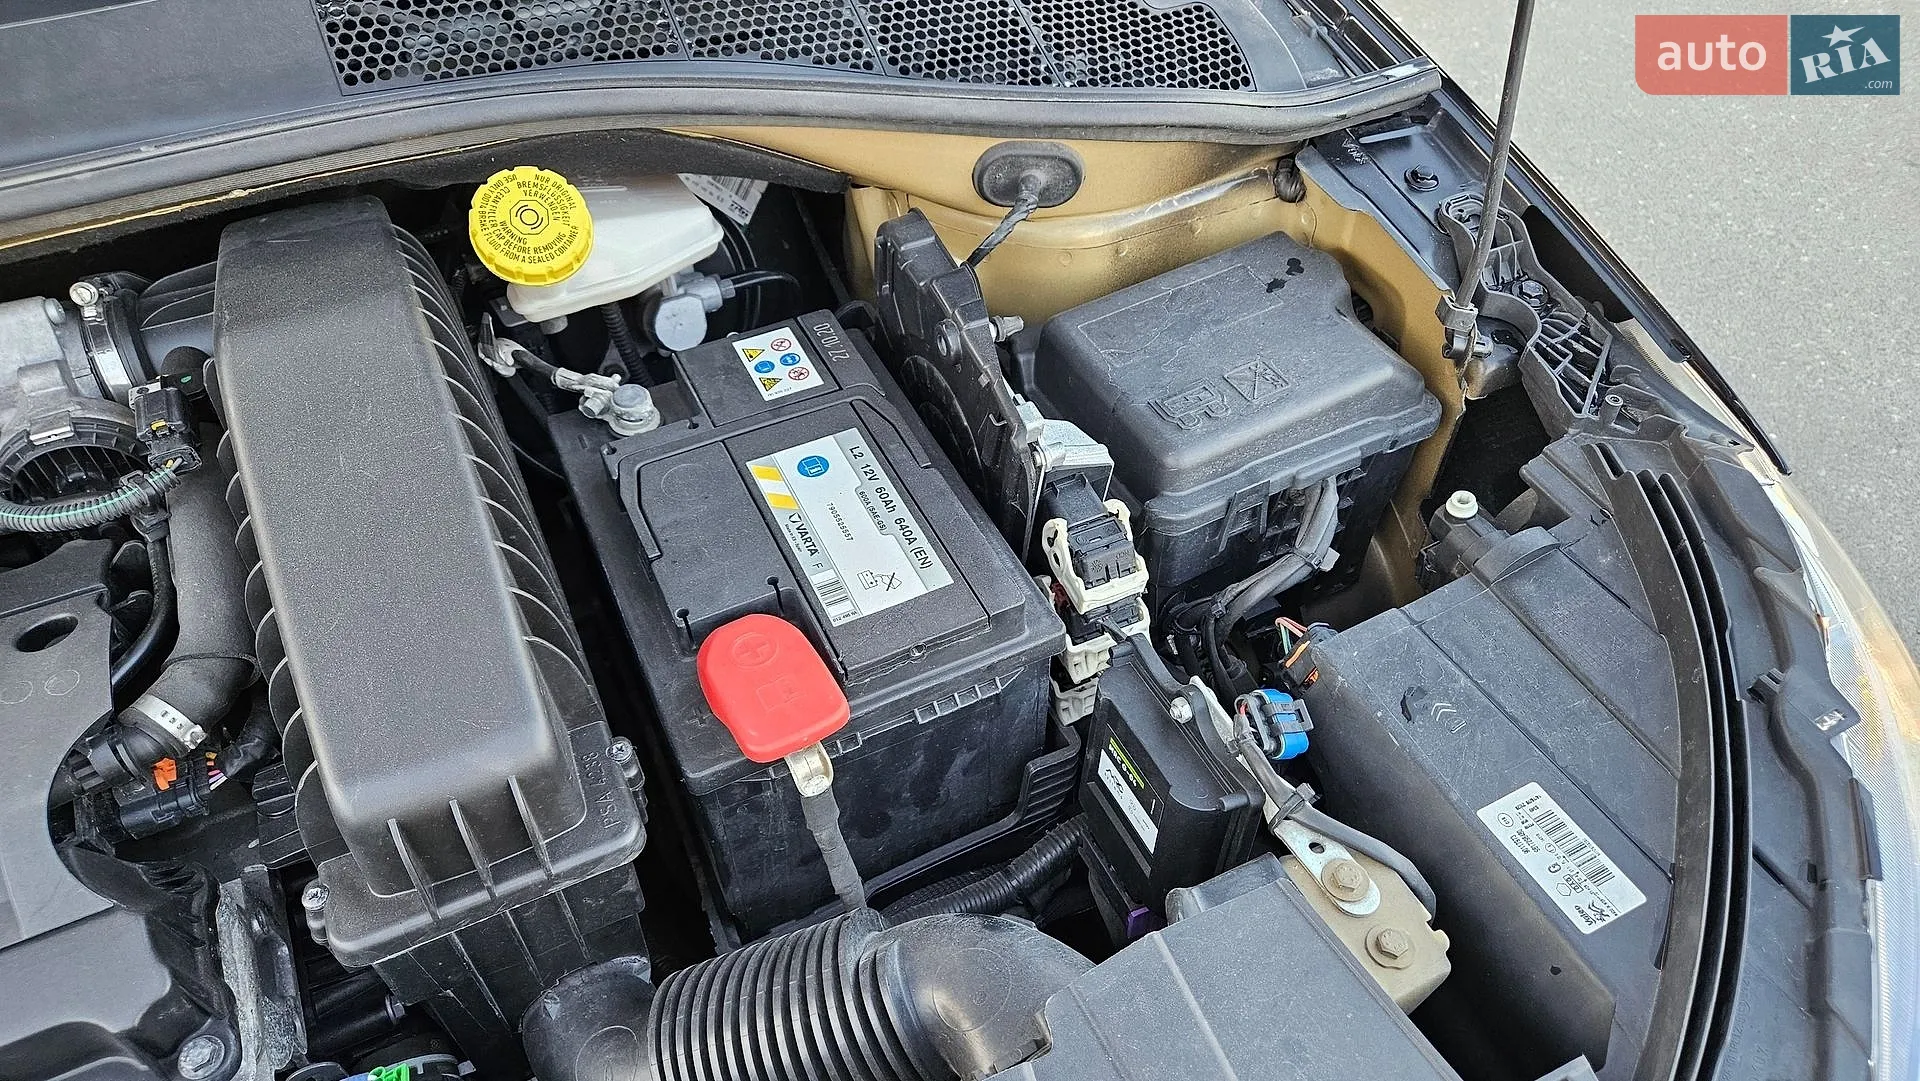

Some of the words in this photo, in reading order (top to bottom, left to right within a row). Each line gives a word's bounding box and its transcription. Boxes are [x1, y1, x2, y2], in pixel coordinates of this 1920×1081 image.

[487, 179, 504, 195] ONLY
[502, 173, 518, 184] USE
[491, 186, 511, 205] CLEAN
[535, 173, 551, 185] NUR
[551, 181, 577, 210] ORIGINAL
[522, 189, 561, 221] VERWENDEN
[478, 210, 490, 233] BRAKE
[487, 204, 499, 229] FILLER
[483, 231, 502, 251] FLUID
[492, 228, 506, 241] CAP
[499, 220, 528, 246] WARNING
[533, 231, 567, 255] REMOVING
[553, 225, 579, 257] CONTAINER
[499, 247, 521, 262] FROM
[503, 238, 531, 255] BEFORE
[520, 255, 526, 263] A
[527, 252, 556, 264] SEALED
[813, 322, 850, 362] 27.10.20
[849, 445, 864, 460] L2
[860, 463, 880, 482] 12V
[875, 486, 897, 514] 60Ah
[894, 517, 918, 546] 640A
[909, 546, 934, 570] (EN)
[859, 490, 870, 505] 600A
[796, 523, 820, 557] VARTA
[594, 790, 621, 829] PSA
[1574, 905, 1596, 926] Valeo
